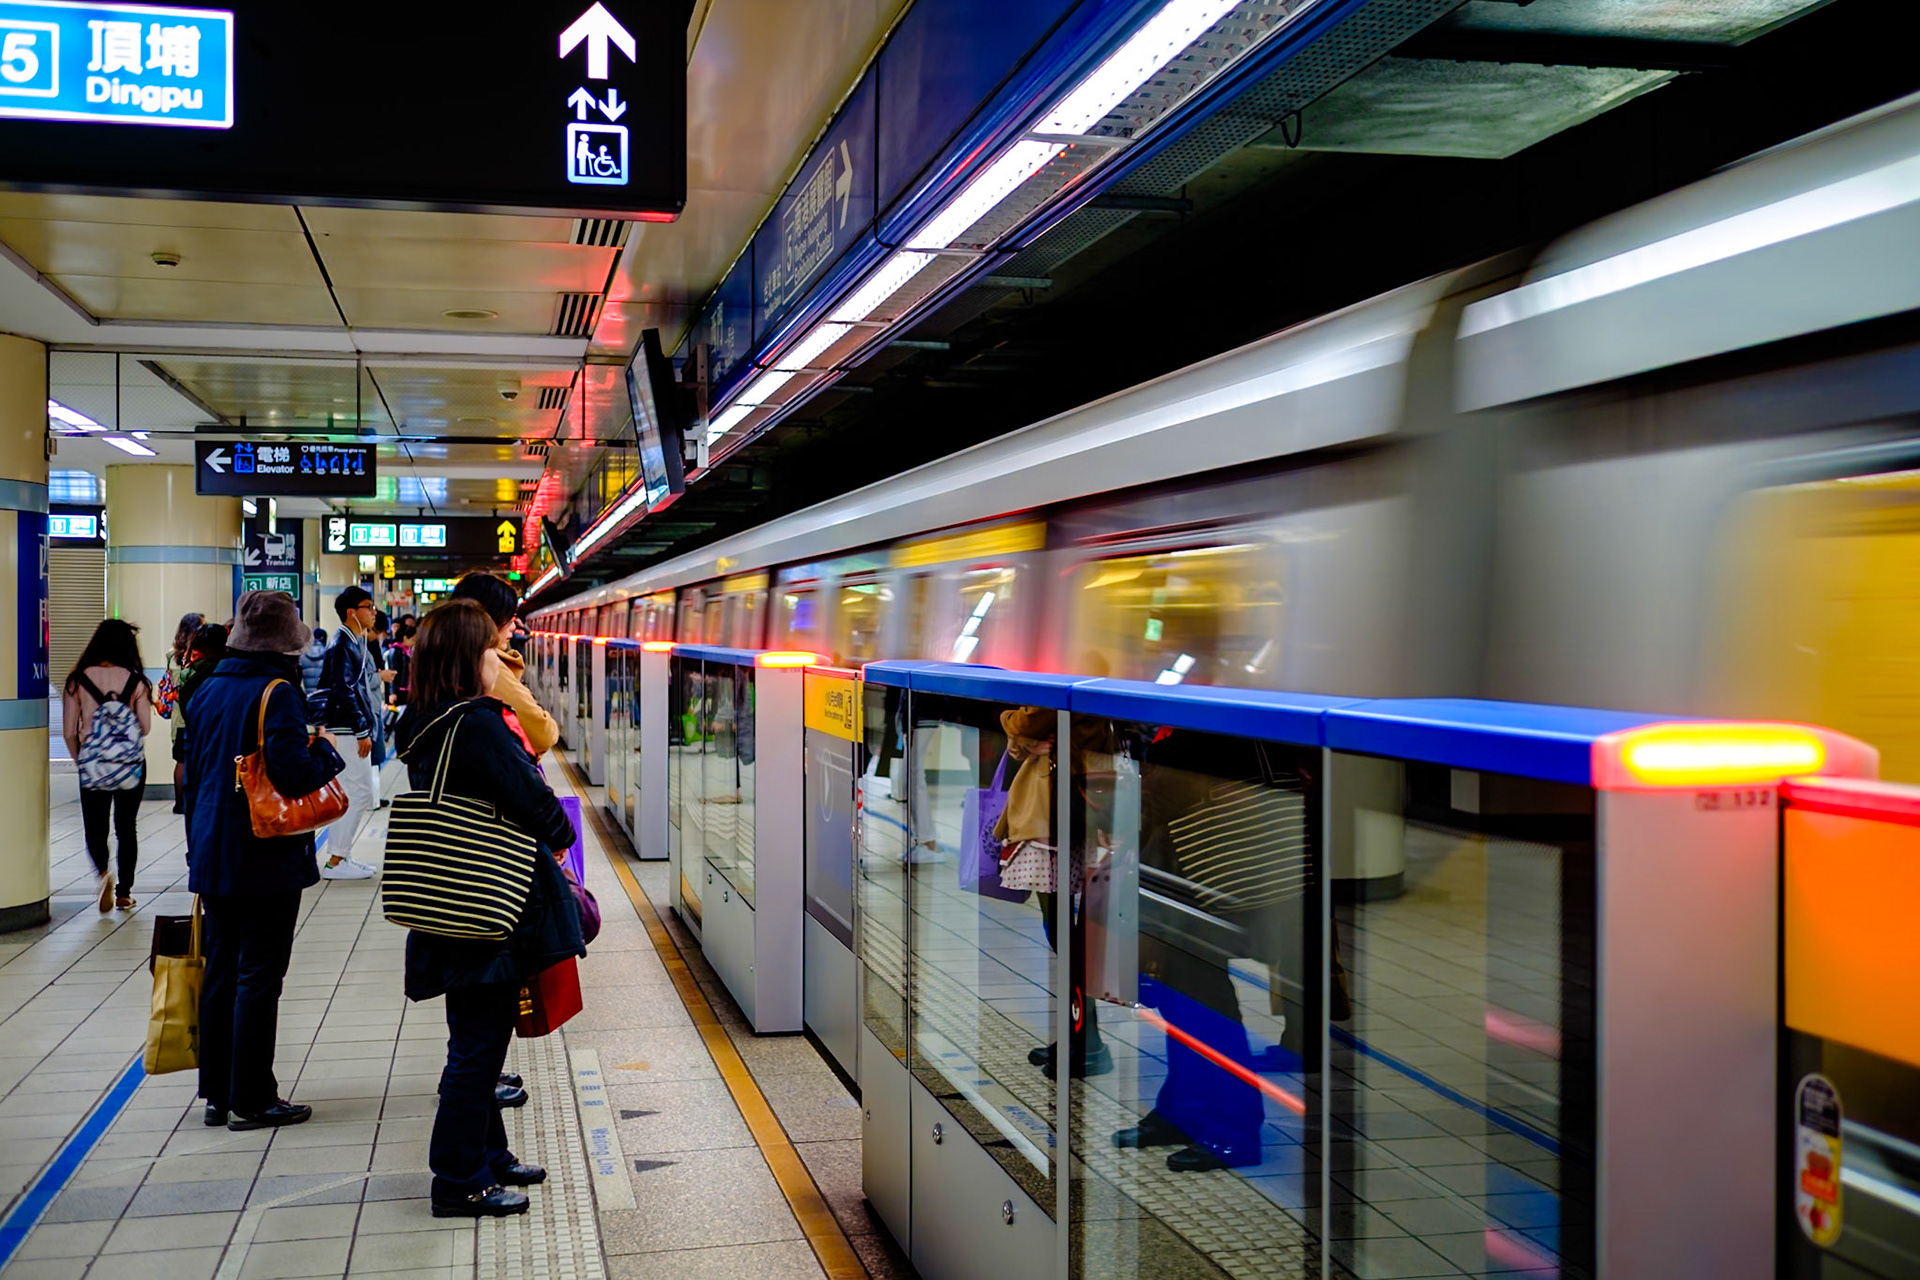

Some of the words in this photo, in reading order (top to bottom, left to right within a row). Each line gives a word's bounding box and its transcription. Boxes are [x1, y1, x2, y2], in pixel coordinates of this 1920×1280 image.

[0, 32, 40, 83] 5
[87, 19, 202, 78] 頂埔
[86, 76, 204, 113] Dingpu
[786, 234, 792, 272] 5
[256, 445, 291, 463] 電梯
[256, 463, 295, 474] Elevator
[249, 581, 258, 591] 3
[266, 577, 291, 590] 新店
[590, 1127, 612, 1156] Waiting
[597, 1157, 616, 1175] Line
